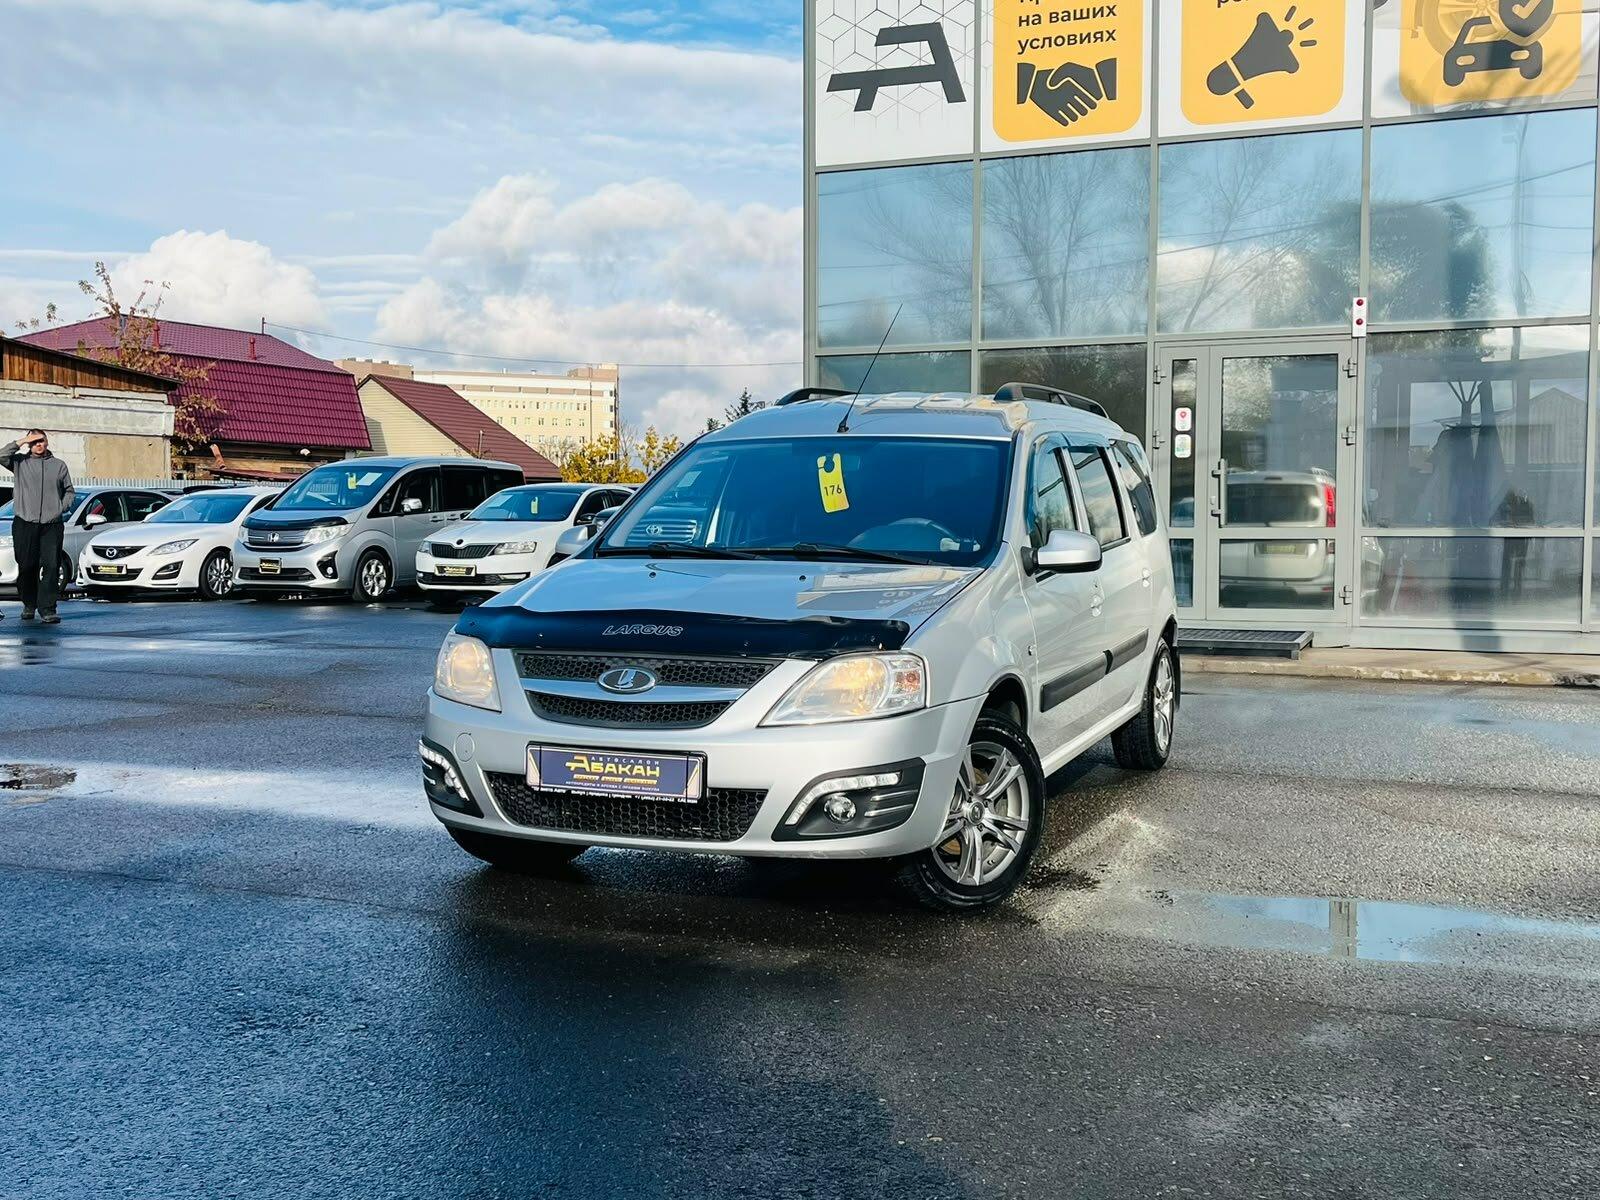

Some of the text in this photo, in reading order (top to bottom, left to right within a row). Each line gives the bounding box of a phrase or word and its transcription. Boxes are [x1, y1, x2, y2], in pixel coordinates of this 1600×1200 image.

[1018, 4, 1117, 27] на ваших
[1017, 29, 1117, 55] условиях
[823, 484, 843, 497] 176
[601, 623, 684, 637] LARGUS
